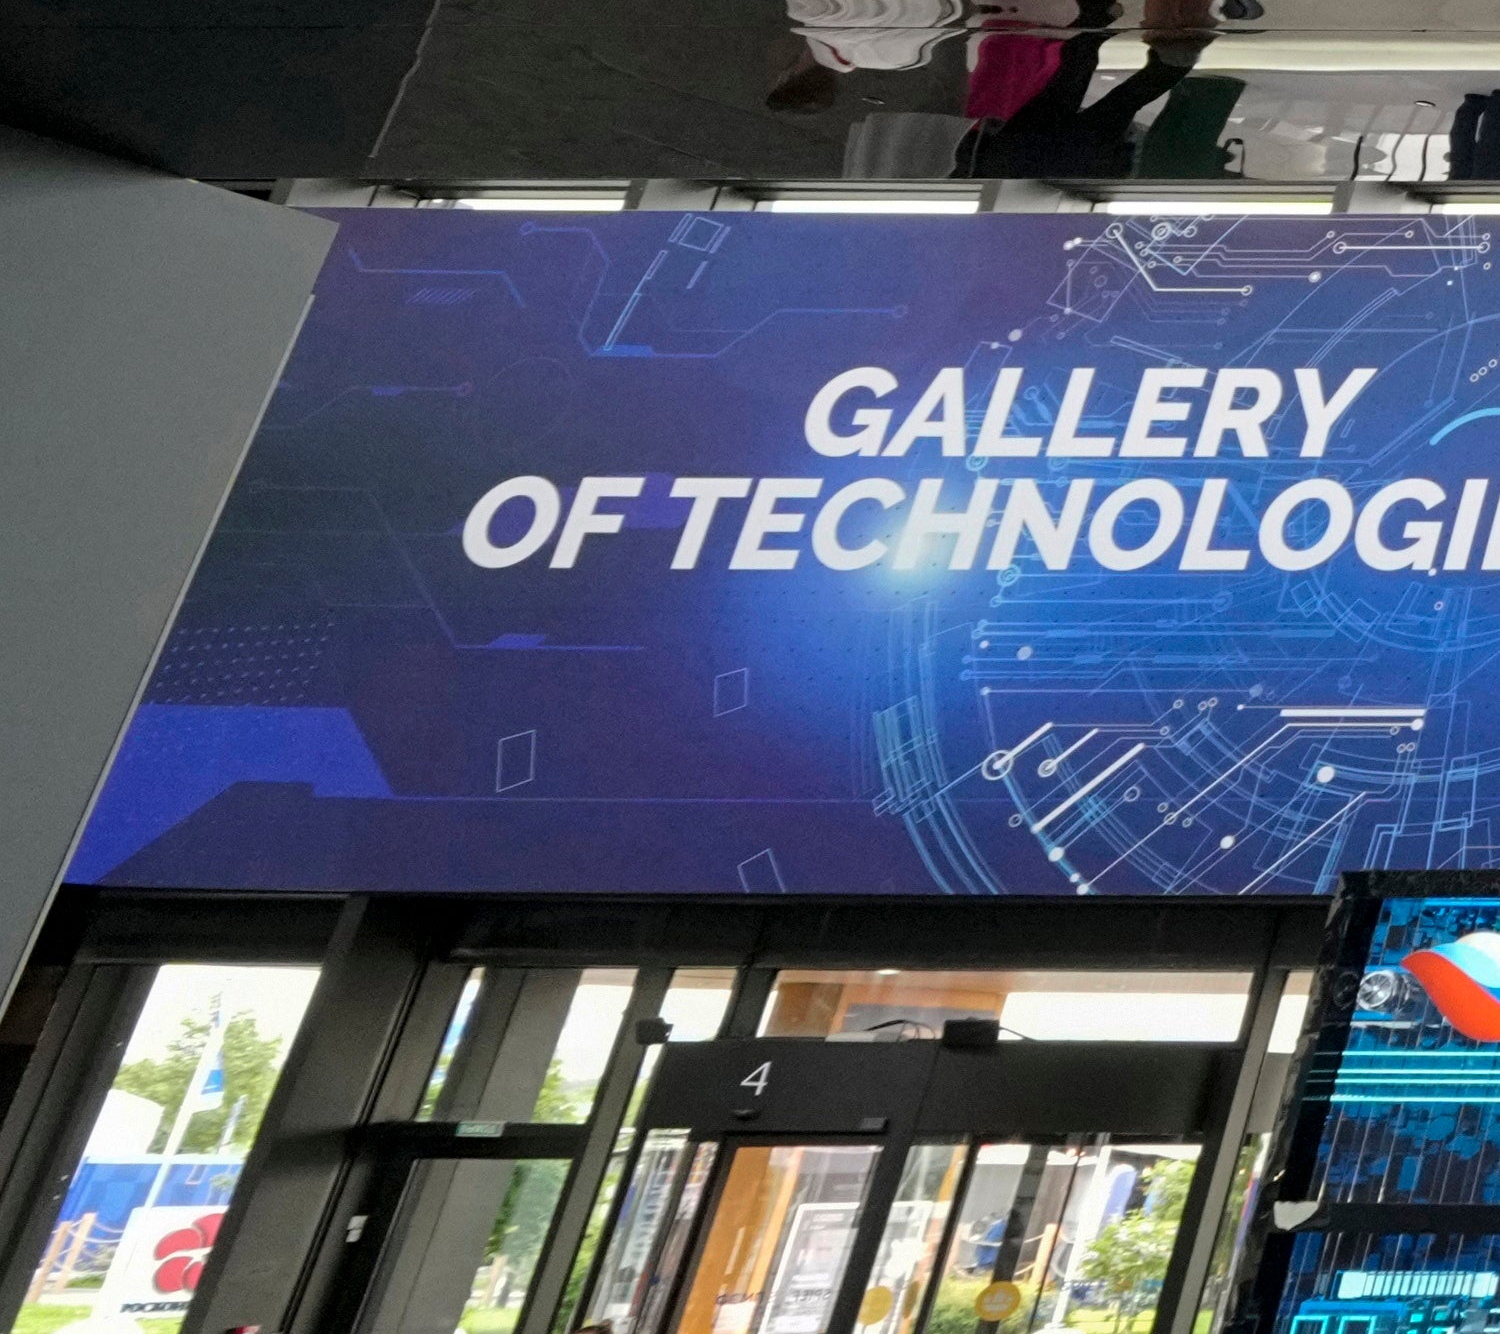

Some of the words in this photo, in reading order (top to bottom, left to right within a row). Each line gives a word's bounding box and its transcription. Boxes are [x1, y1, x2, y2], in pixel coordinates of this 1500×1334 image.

[805, 366, 1373, 458] GALLERY
[463, 474, 645, 570] OF
[740, 1061, 770, 1096] 4
